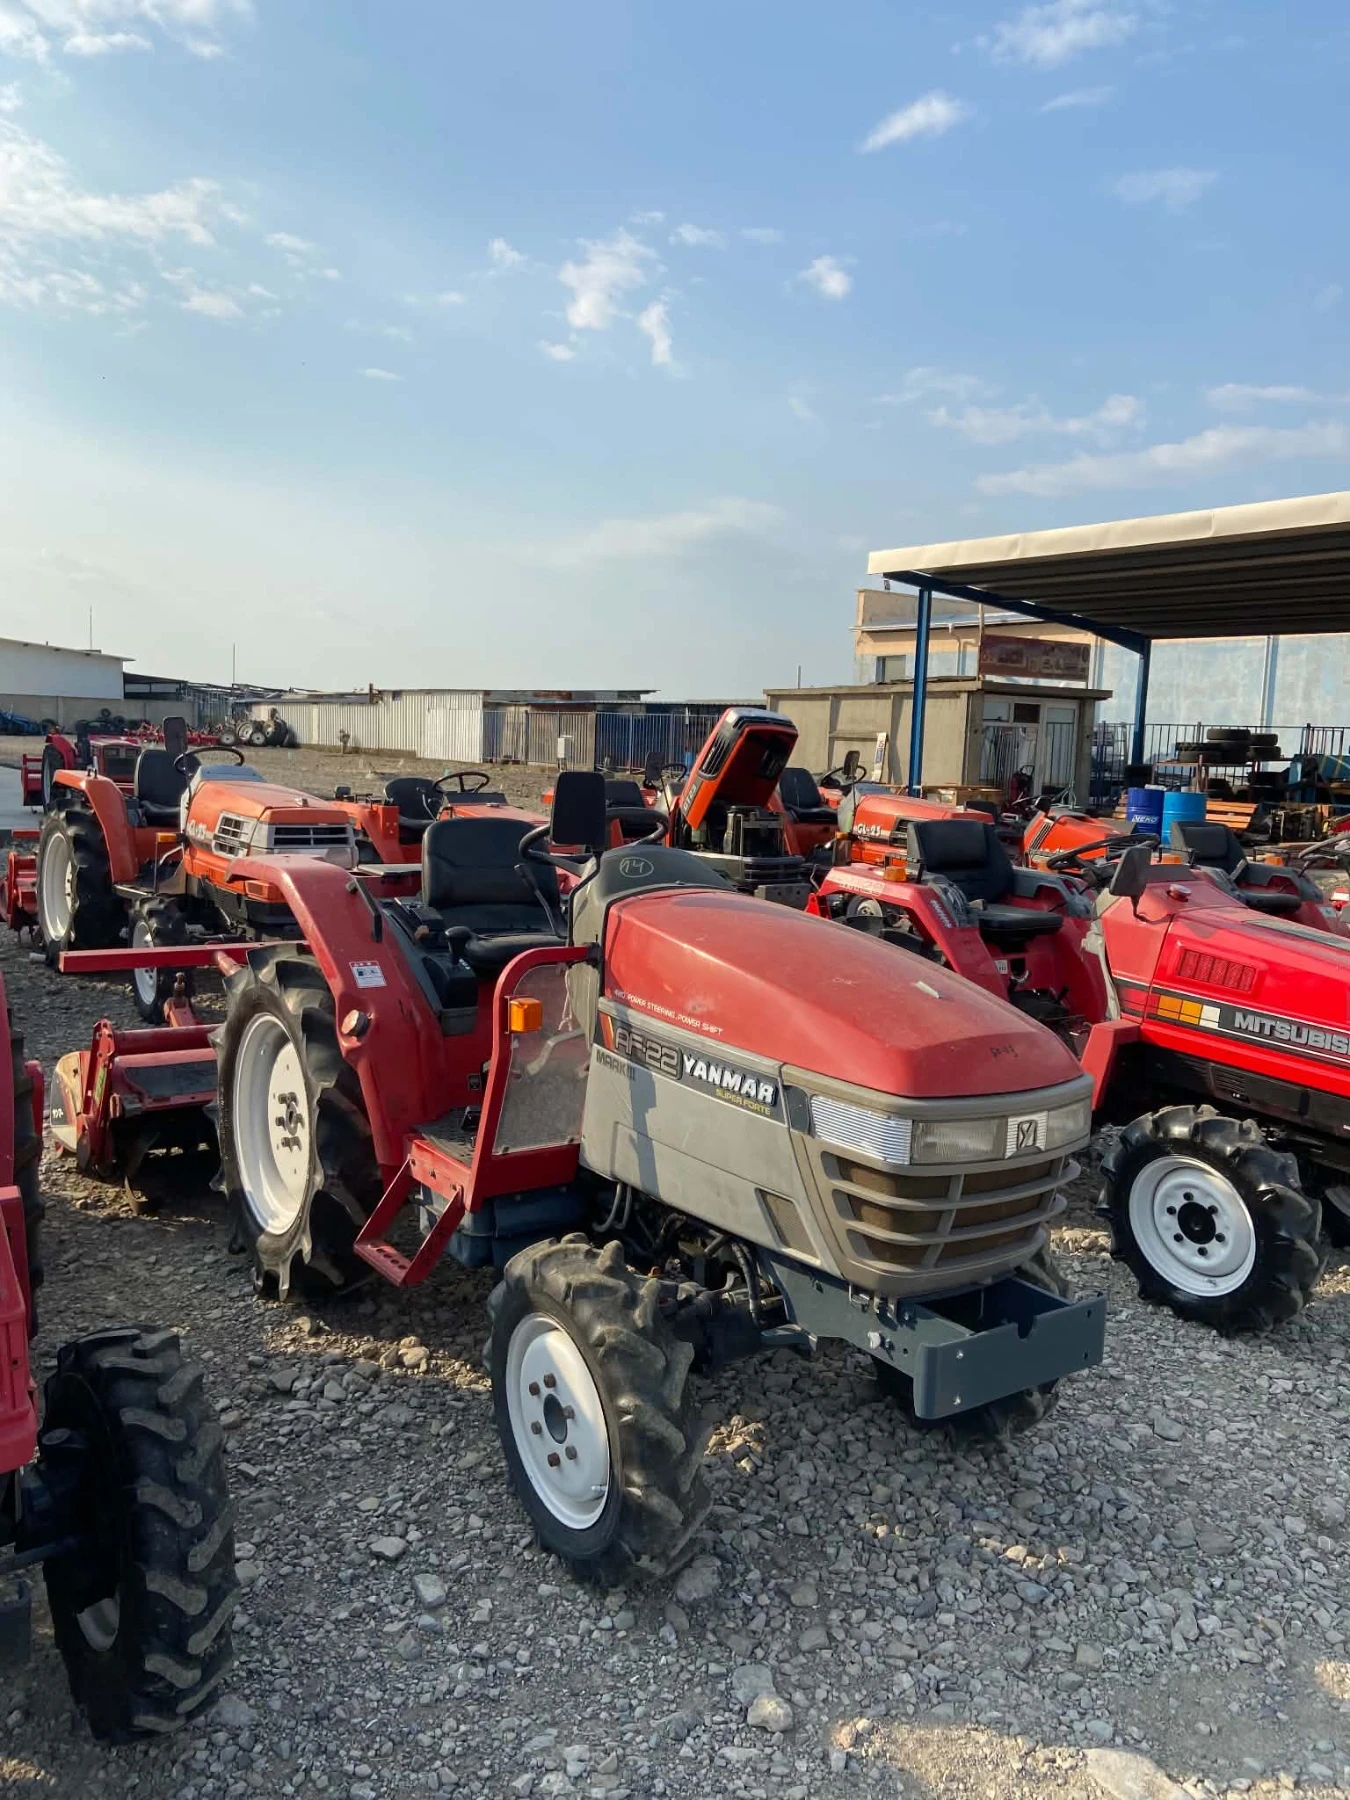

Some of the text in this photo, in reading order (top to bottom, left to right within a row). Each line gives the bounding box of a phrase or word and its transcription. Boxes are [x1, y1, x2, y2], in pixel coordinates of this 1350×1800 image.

[627, 993, 646, 1007] POWER
[678, 1013, 701, 1028] POWER
[702, 1022, 724, 1036] SHIFT
[1234, 1011, 1350, 1056] MITSUBIS
[596, 1049, 627, 1077] MARK
[683, 1053, 777, 1105] YANMAR
[716, 1088, 771, 1117] SUPER FORTE
